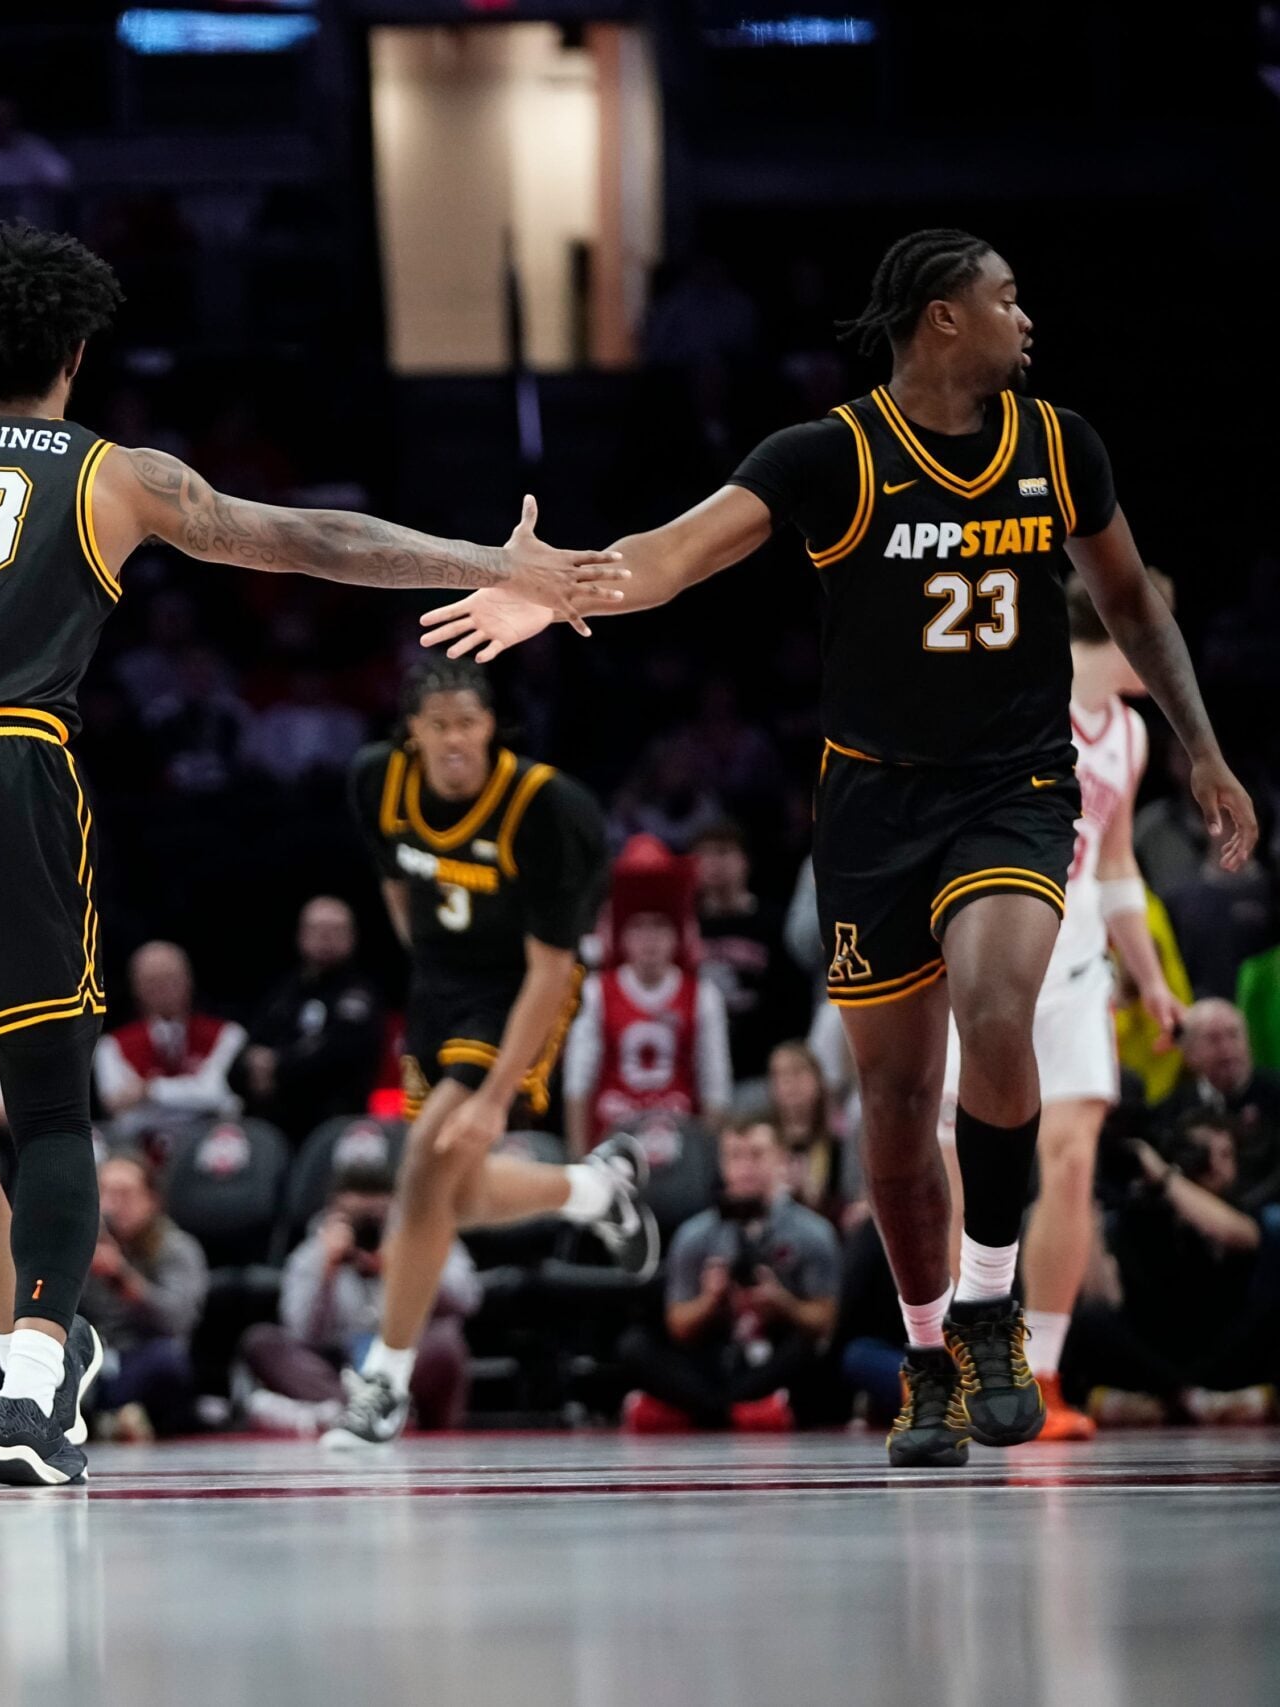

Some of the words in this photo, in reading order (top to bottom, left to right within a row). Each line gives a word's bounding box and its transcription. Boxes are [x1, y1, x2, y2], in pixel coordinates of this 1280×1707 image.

[923, 569, 1019, 653] 23
[436, 880, 472, 934] 3
[828, 921, 873, 981] A
